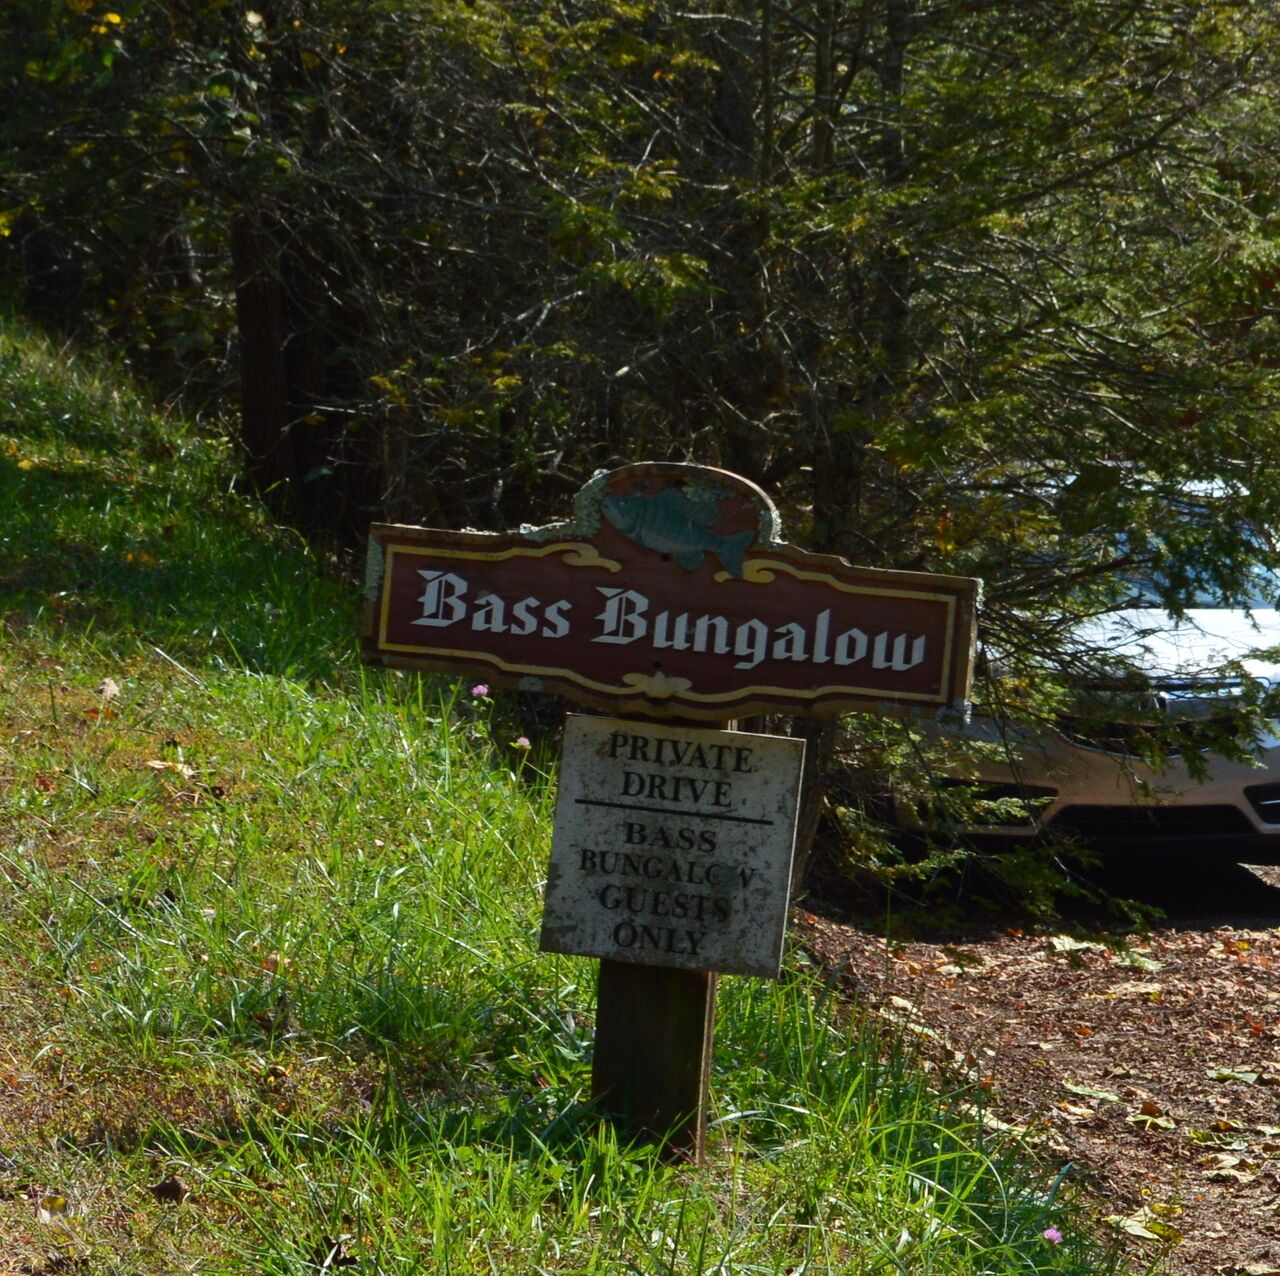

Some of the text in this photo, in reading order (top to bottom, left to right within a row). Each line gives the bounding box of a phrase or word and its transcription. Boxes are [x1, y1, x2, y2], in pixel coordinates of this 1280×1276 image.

[410, 569, 926, 672] Bass Bungalow
[607, 731, 753, 773] PRIVATE
[620, 771, 733, 807] DRIVE
[623, 821, 717, 853] BASS
[599, 883, 730, 923] GUESTS
[613, 921, 707, 956] ONLY
